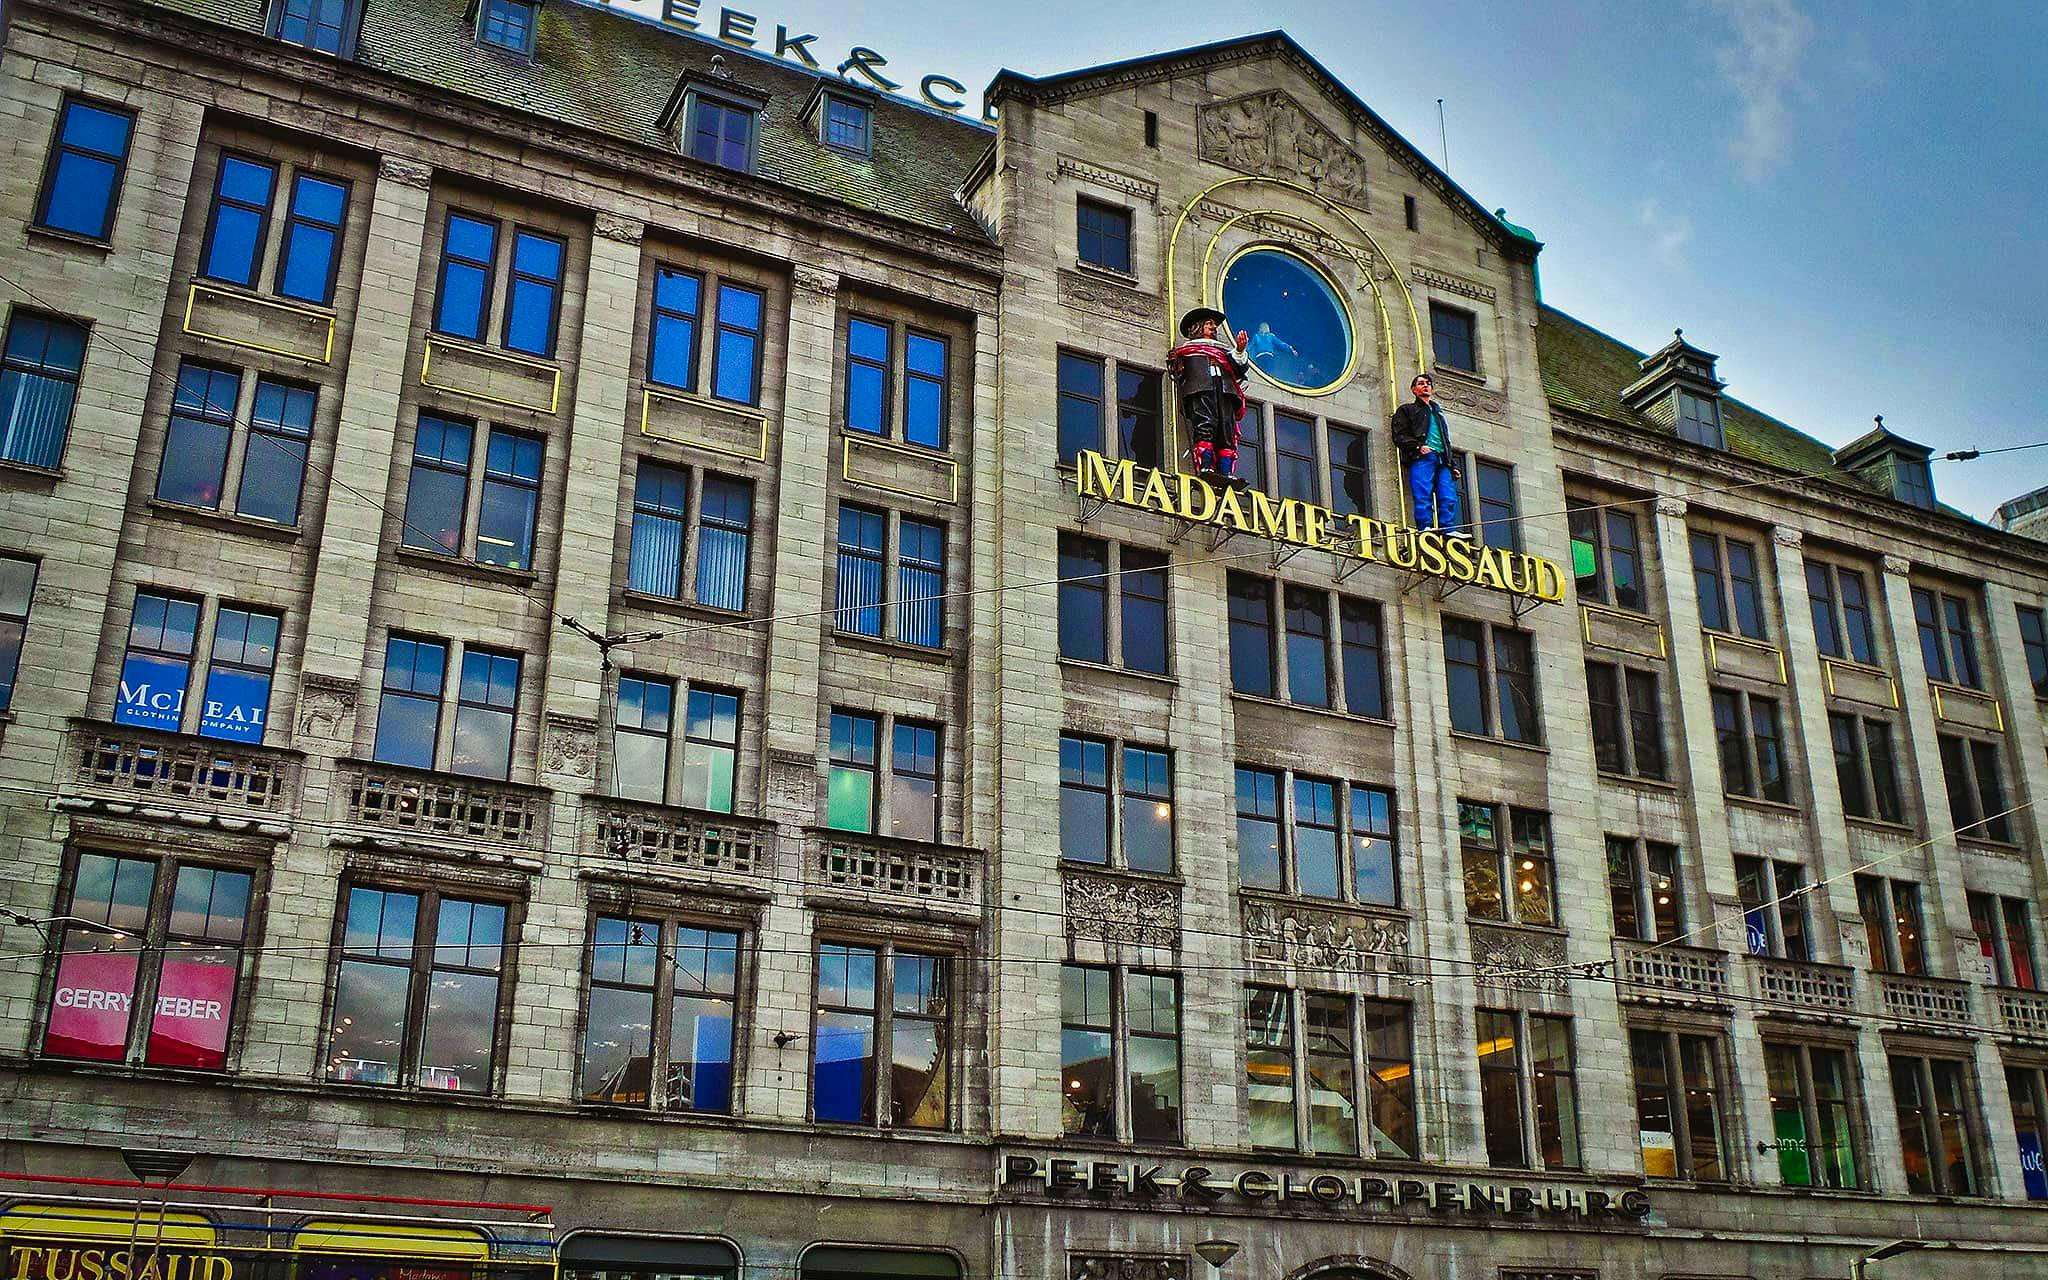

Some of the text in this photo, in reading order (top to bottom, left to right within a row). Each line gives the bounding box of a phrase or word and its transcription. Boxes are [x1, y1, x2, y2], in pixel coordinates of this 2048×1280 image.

[602, 0, 821, 68] EEK
[837, 46, 904, 91] &
[1077, 448, 1567, 606] MADAME TUSSAUD
[126, 708, 250, 732] CLOTHIN OMPANY
[55, 987, 133, 1012] GERRY
[1000, 1155, 1651, 1217] PEEK & CLOPPENBURG
[10, 1245, 234, 1280] TUSSAUD
